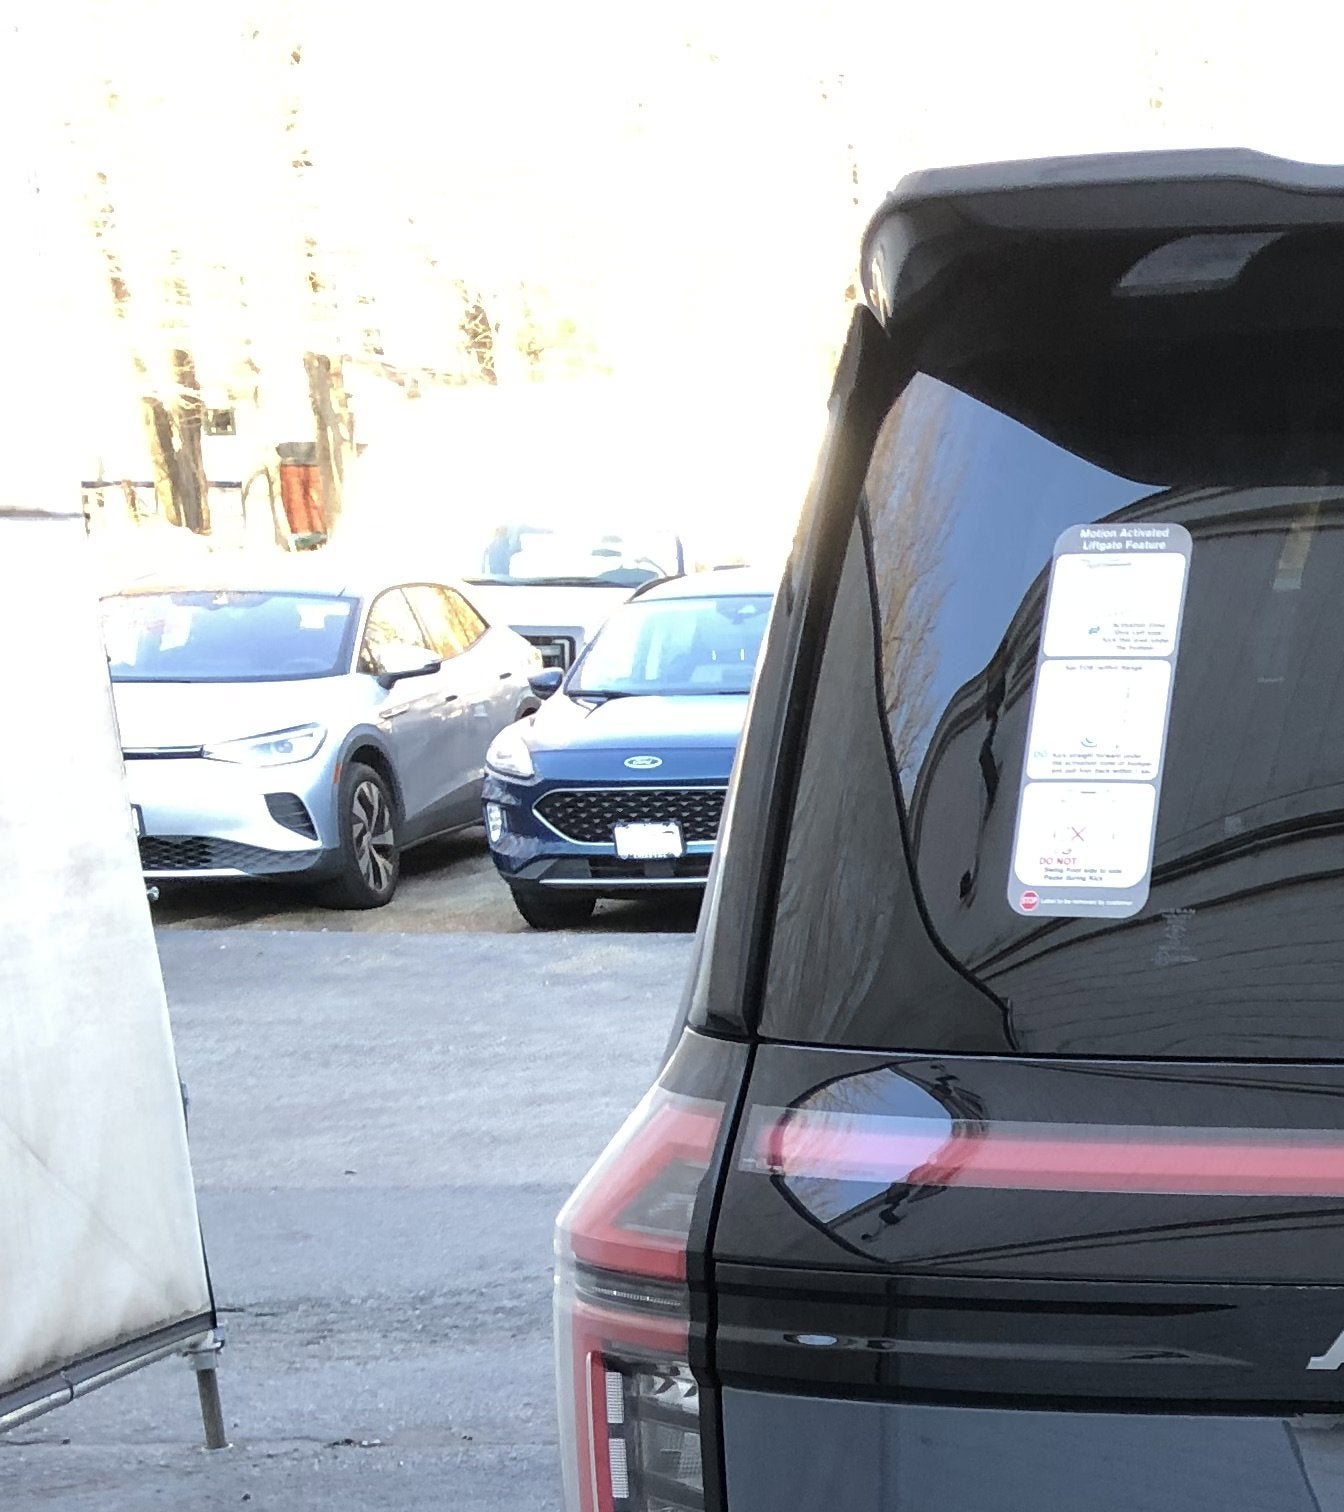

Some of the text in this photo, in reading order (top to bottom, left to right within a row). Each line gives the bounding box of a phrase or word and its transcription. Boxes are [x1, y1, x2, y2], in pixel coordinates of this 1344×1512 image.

[1080, 527, 1170, 538] Motion Activated
[1083, 541, 1167, 551] Liftgate Feature
[1057, 857, 1077, 866] NOT
